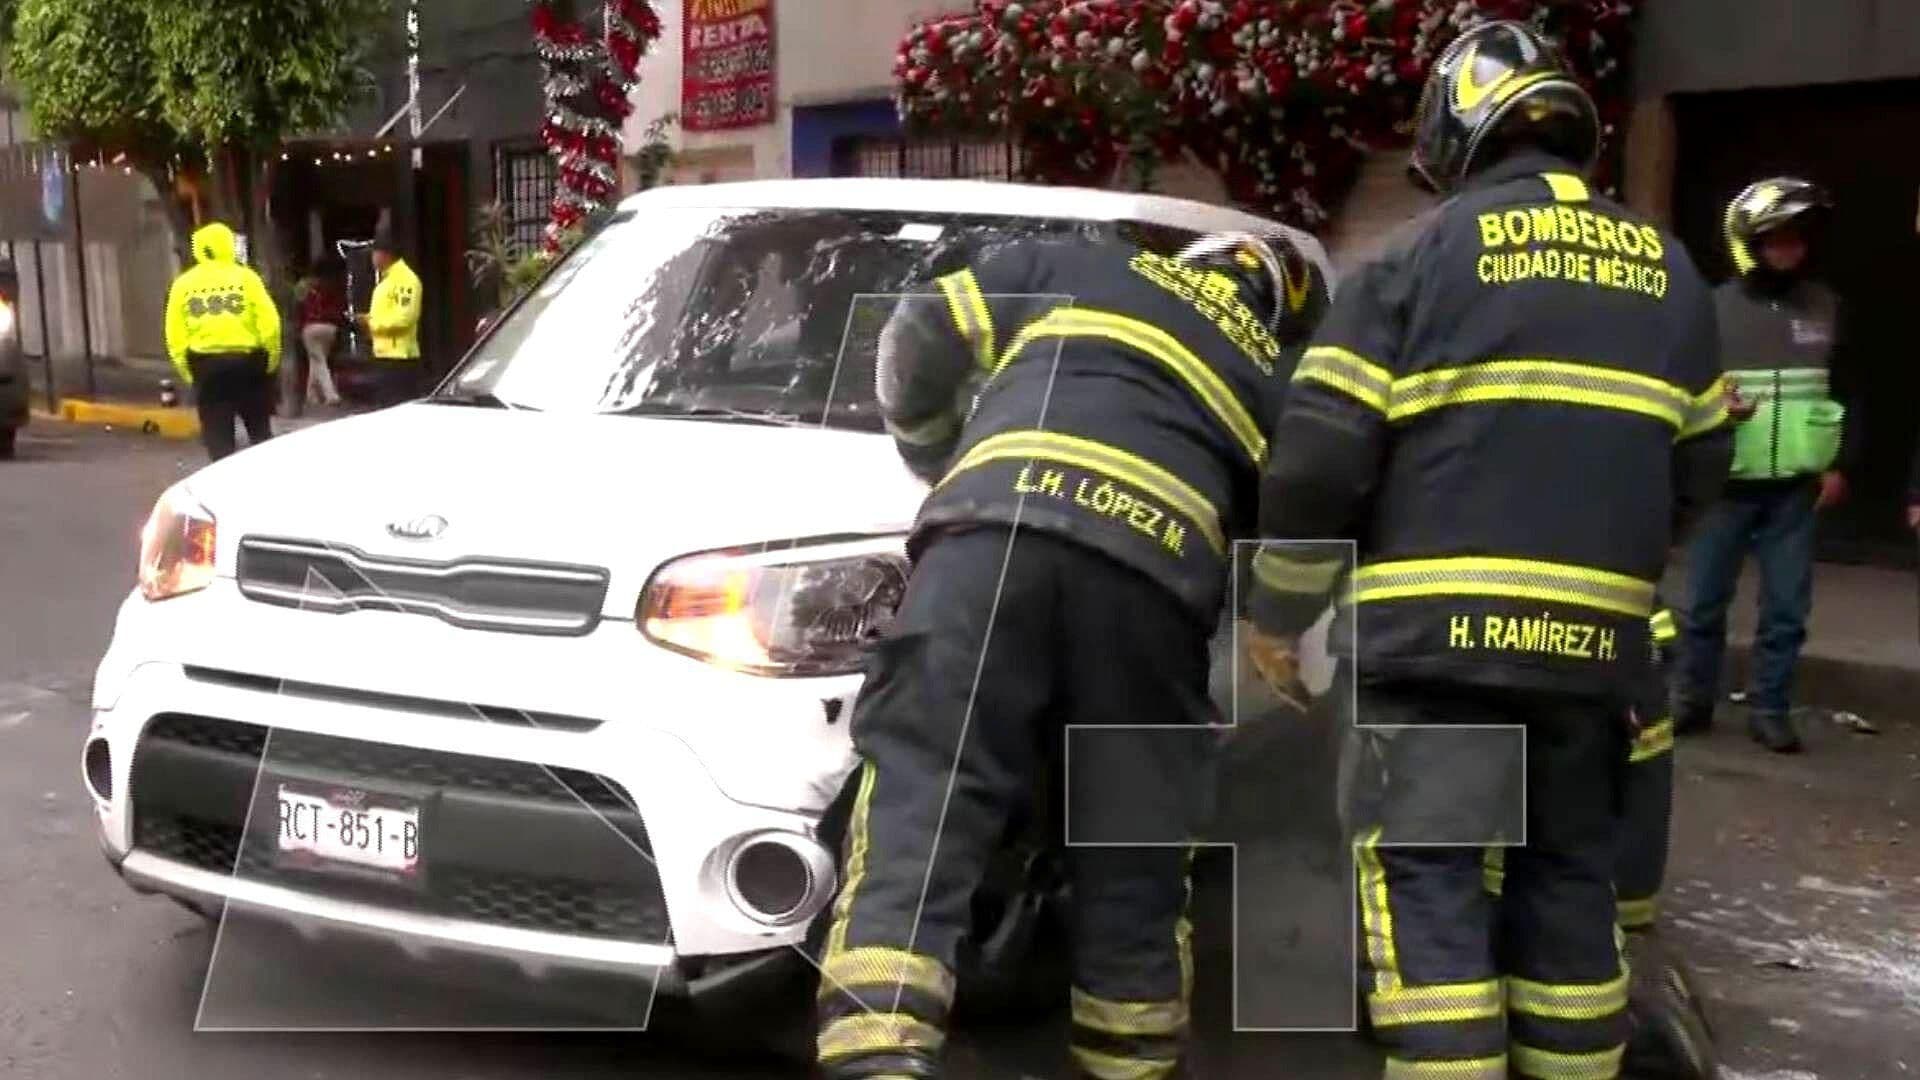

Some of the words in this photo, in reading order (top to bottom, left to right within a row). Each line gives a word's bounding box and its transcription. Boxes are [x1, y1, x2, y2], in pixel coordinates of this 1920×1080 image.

[1477, 206, 1664, 260] BOMBEROS
[1477, 250, 1561, 283] CIUDAD
[1565, 252, 1591, 282] DE
[1595, 255, 1669, 298] MÉXICO
[1074, 478, 1164, 537] LÓPEZ
[1450, 615, 1475, 649] H.
[1484, 611, 1595, 658] RAMÍREZ
[1598, 627, 1617, 661] H.
[279, 799, 418, 859] RCT-851-B
